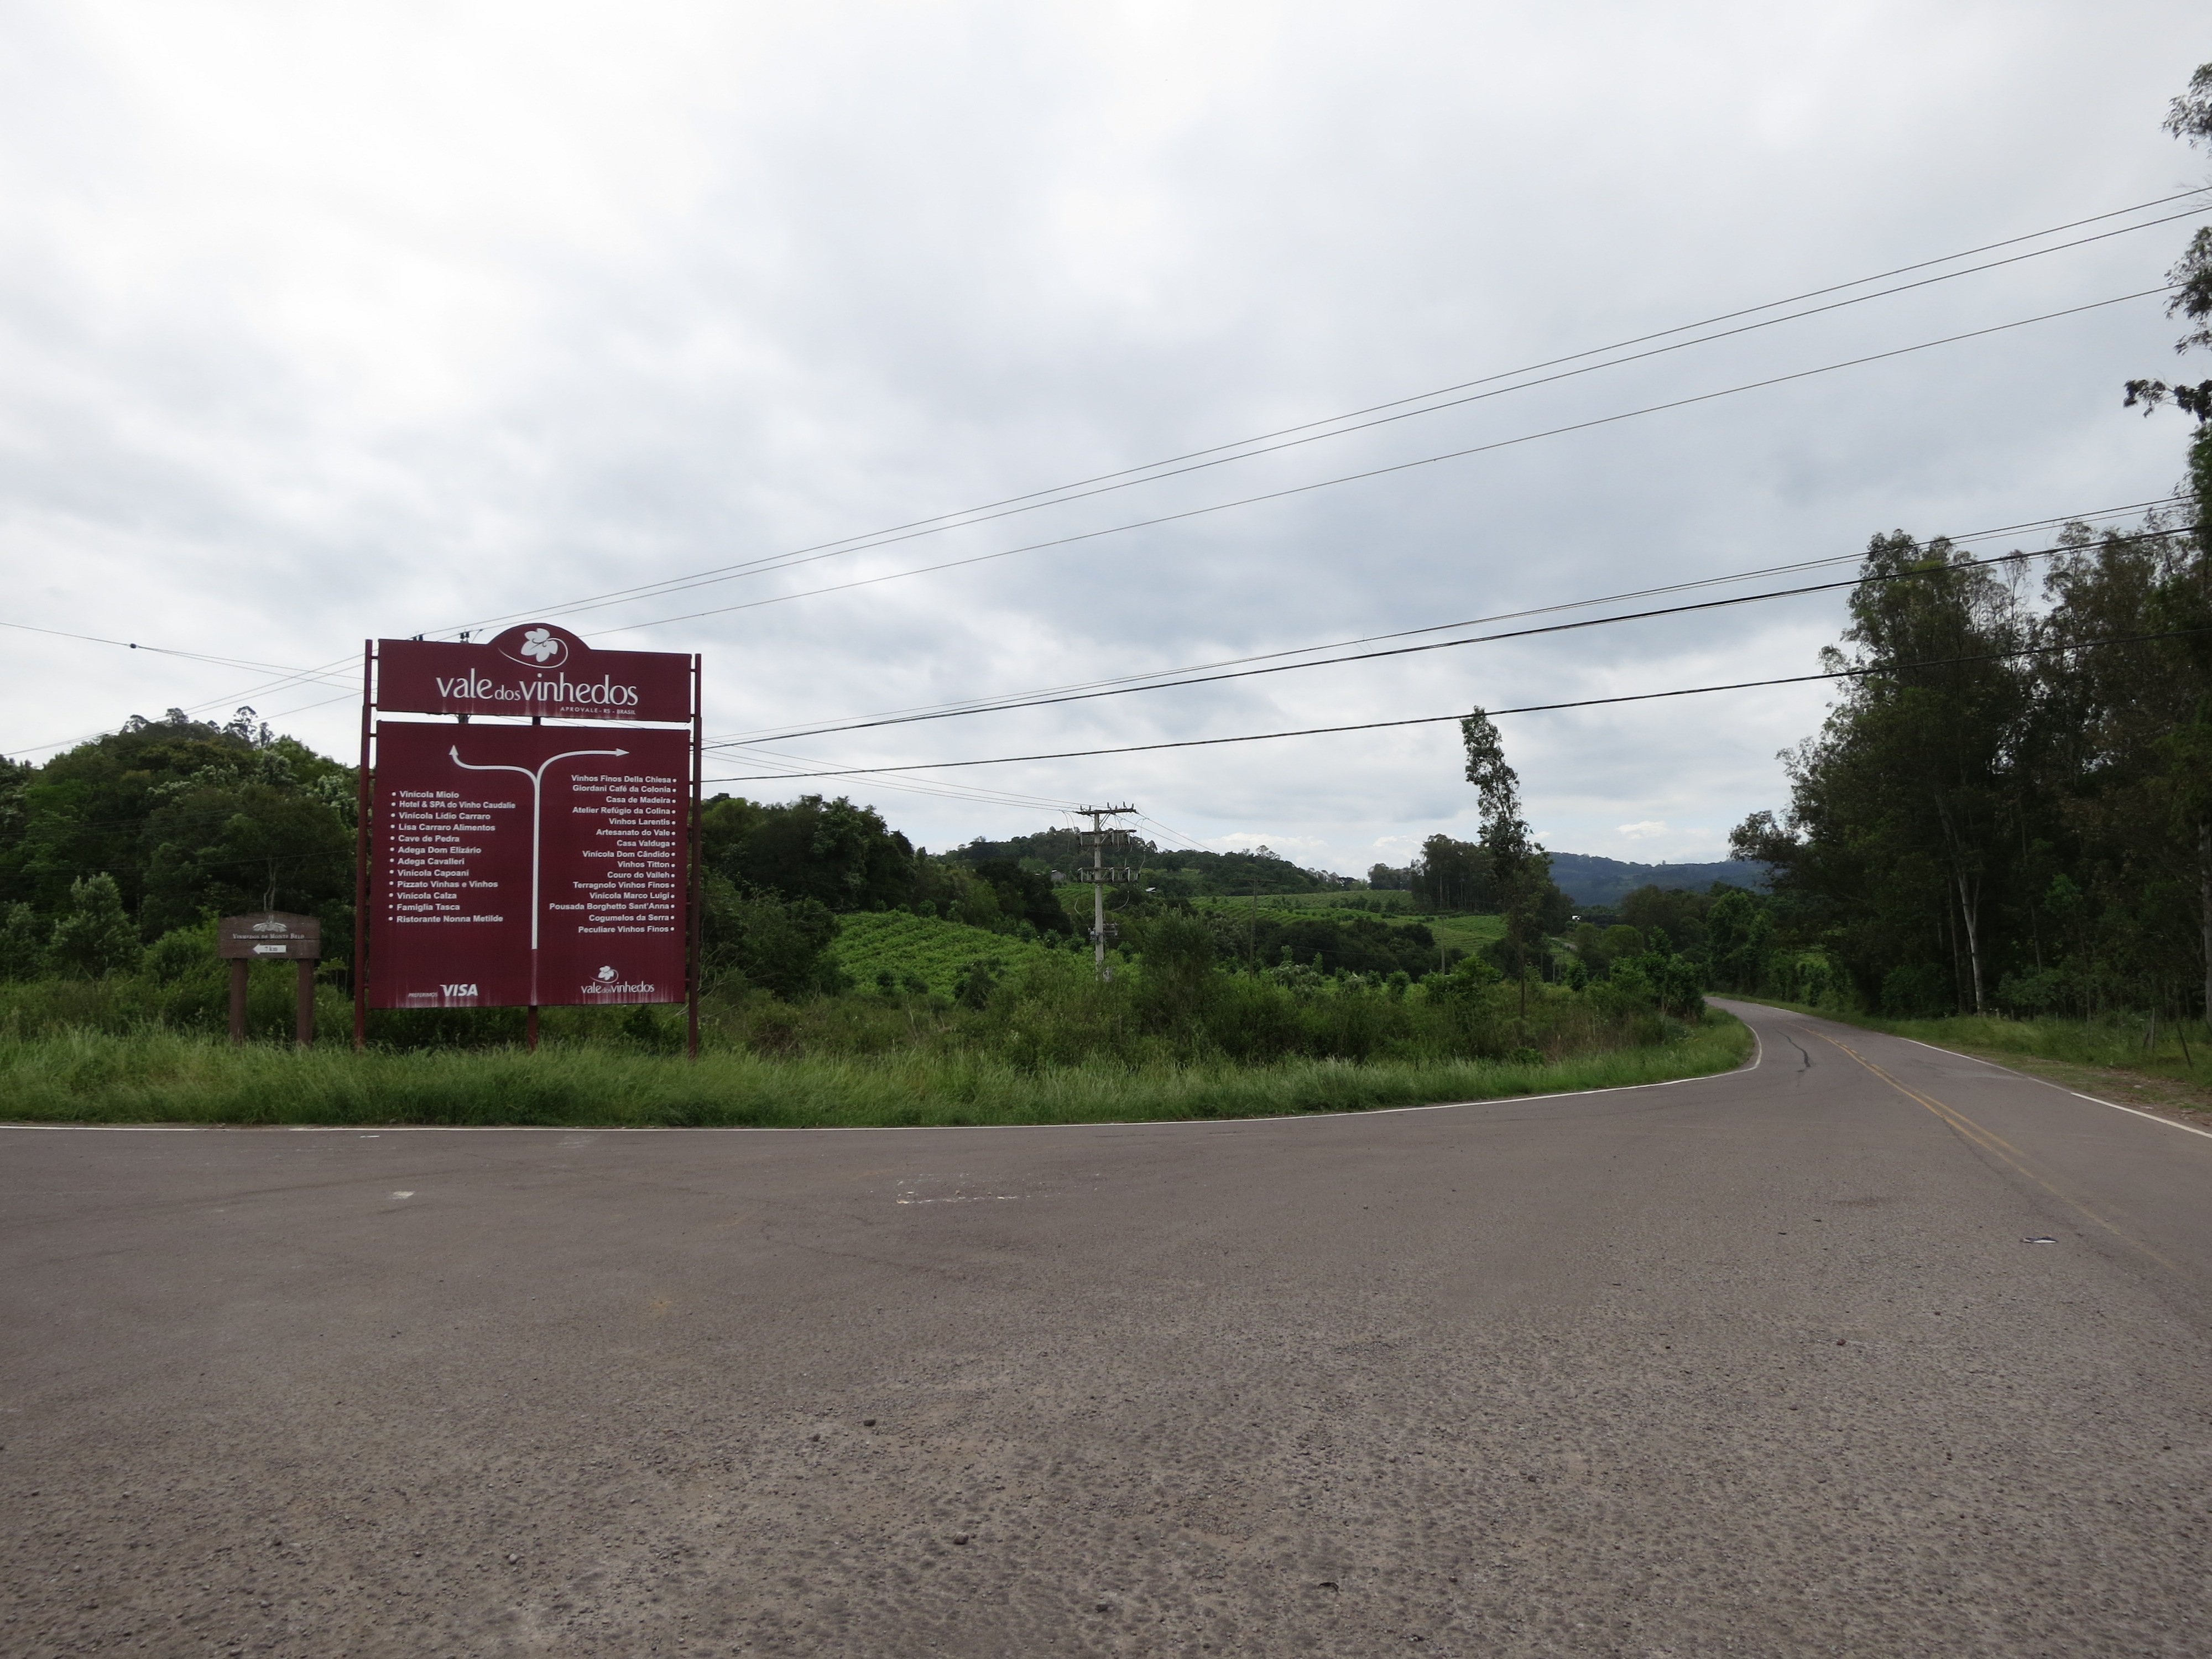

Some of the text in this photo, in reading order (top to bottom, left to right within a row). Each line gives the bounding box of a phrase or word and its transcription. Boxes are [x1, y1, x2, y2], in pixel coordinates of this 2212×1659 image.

[436, 668, 638, 706] vale dos vinhedos
[398, 858, 425, 866] Adega
[434, 869, 469, 878] Capoani
[397, 904, 433, 912] Famiglia
[440, 984, 478, 997] VISA
[581, 982, 602, 993] vale
[611, 981, 655, 993] vinhedos
